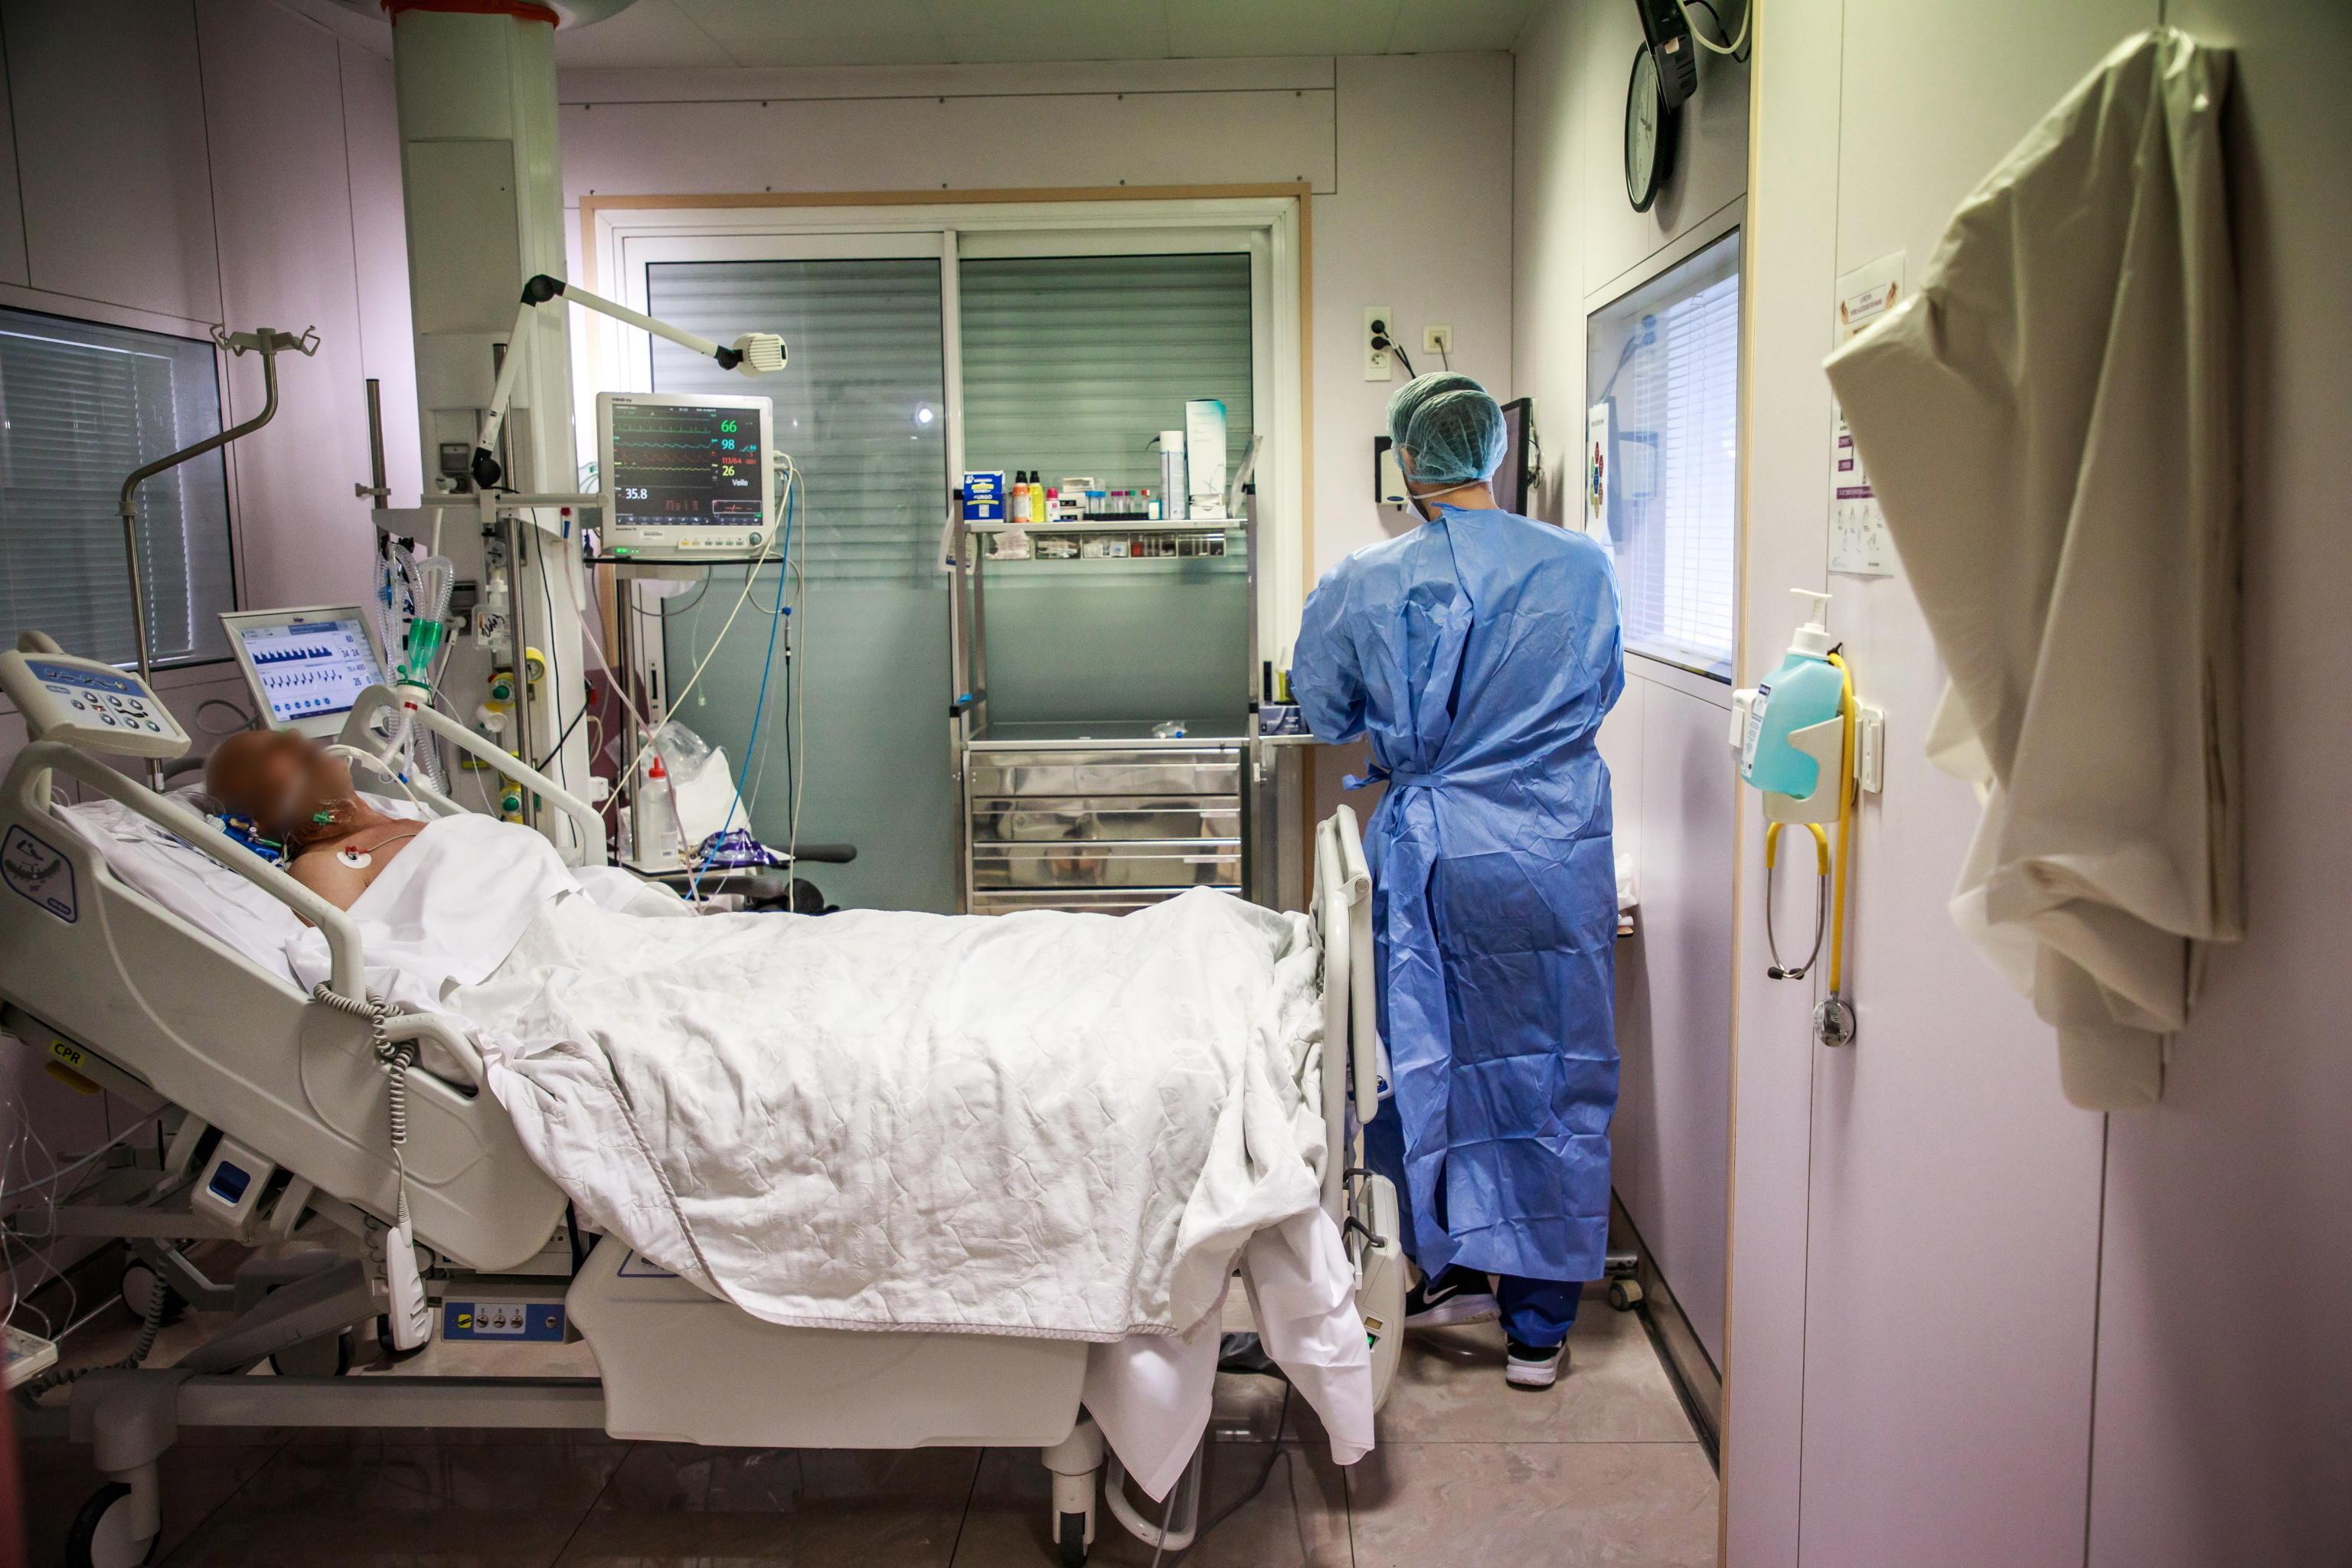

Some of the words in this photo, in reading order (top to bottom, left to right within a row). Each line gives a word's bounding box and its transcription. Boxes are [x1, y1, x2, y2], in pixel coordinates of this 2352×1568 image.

[721, 420, 737, 433] 66
[721, 439, 735, 450] 98
[722, 465, 735, 476] 26
[625, 488, 648, 500] 35.8
[54, 1044, 80, 1064] CPR
